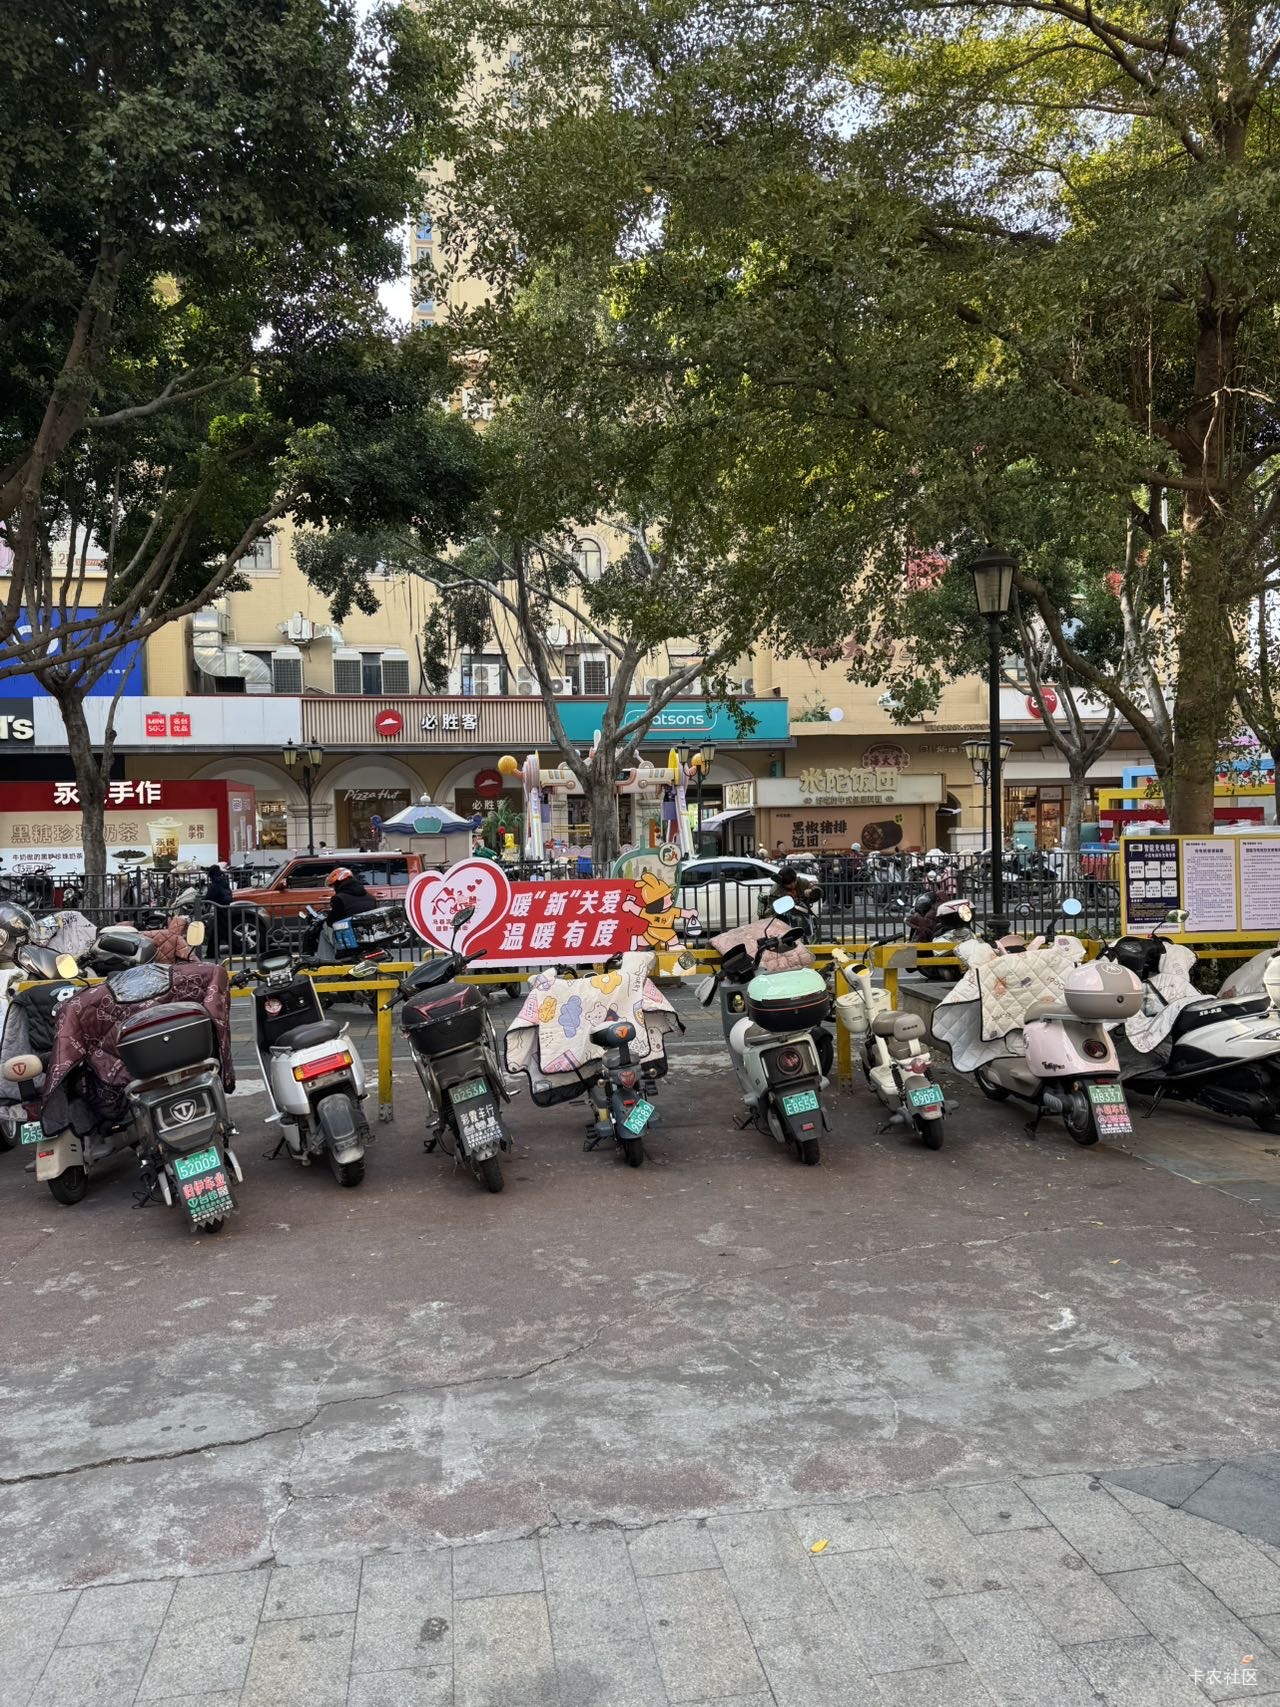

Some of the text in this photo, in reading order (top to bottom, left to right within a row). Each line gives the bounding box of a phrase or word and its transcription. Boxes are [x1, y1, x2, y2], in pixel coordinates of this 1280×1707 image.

[421, 713, 478, 730] 必胜客
[652, 714, 704, 726] atsons
[800, 767, 897, 794] 米陀饭团
[53, 780, 162, 806] 永手作
[344, 789, 401, 802] Pizza Hut
[792, 819, 848, 835] 黑椒猪排
[792, 834, 819, 848] 饭团
[499, 919, 620, 951] 温暖有度
[786, 1097, 817, 1115] E8555
